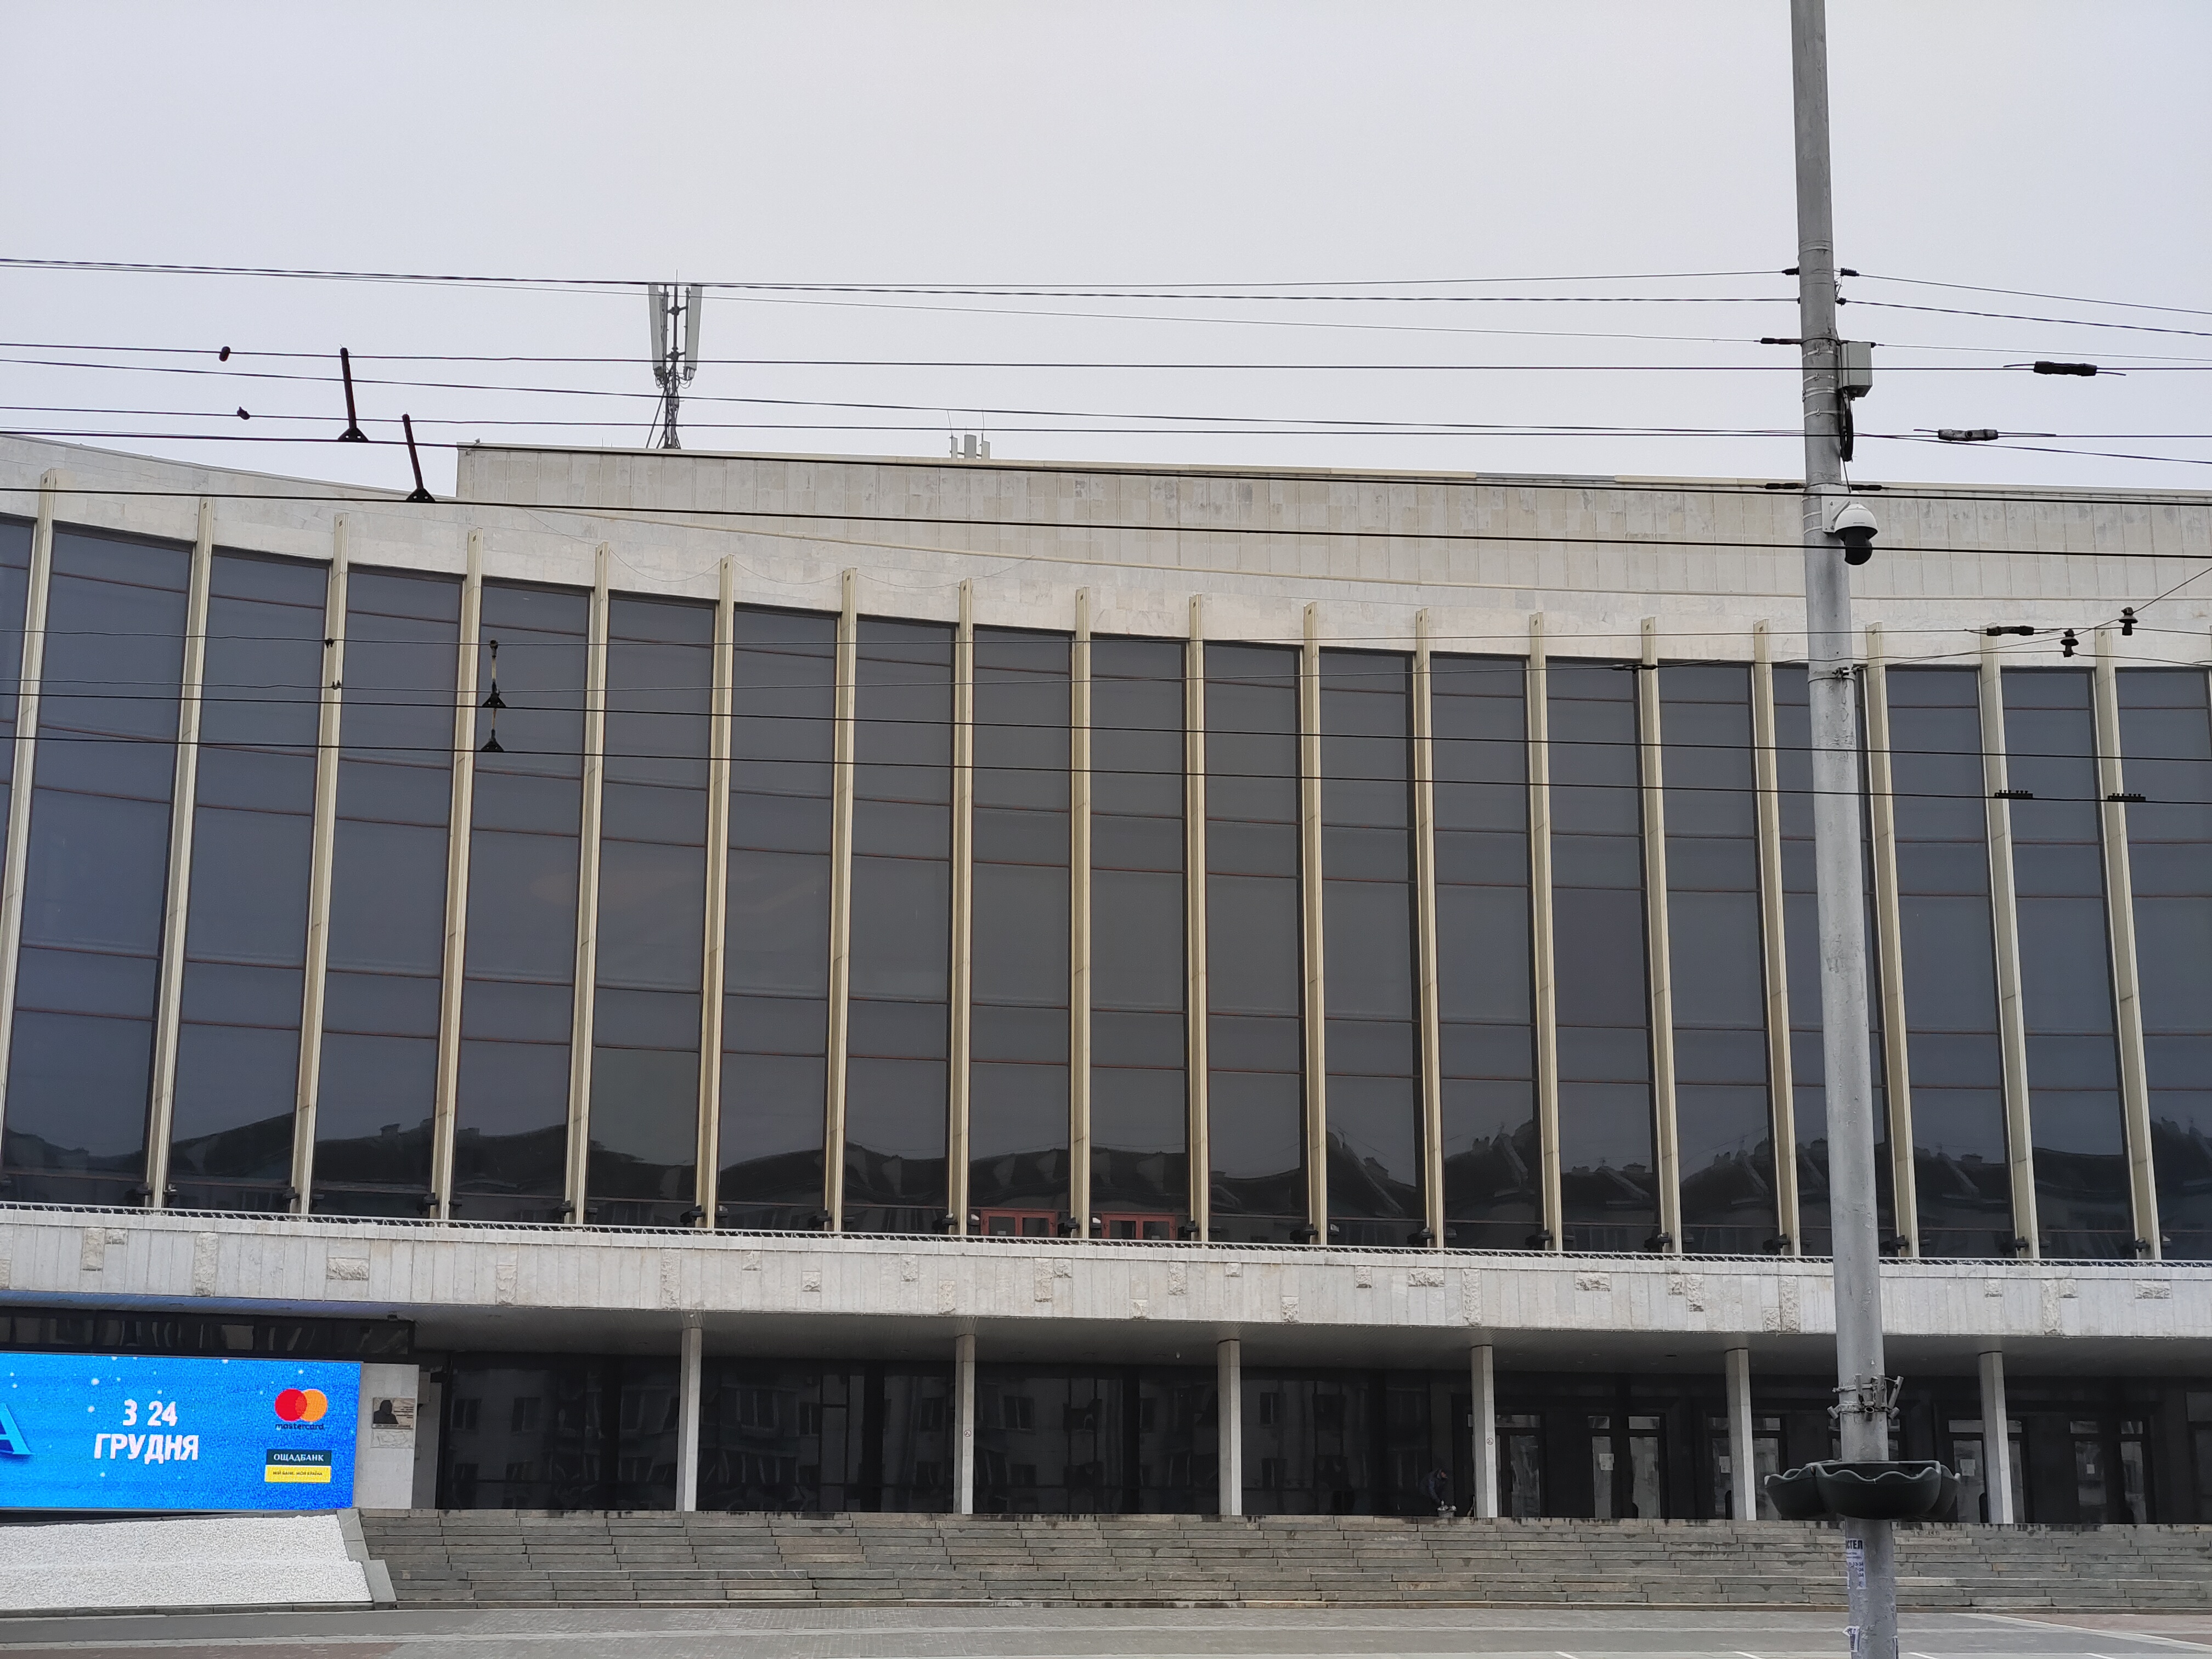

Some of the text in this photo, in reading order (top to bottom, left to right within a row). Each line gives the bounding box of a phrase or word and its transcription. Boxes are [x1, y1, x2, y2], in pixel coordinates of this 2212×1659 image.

[147, 1401, 178, 1427] 24
[94, 1433, 199, 1465] ГРУДНЯ
[273, 1453, 324, 1462] ОЩАДБАНК
